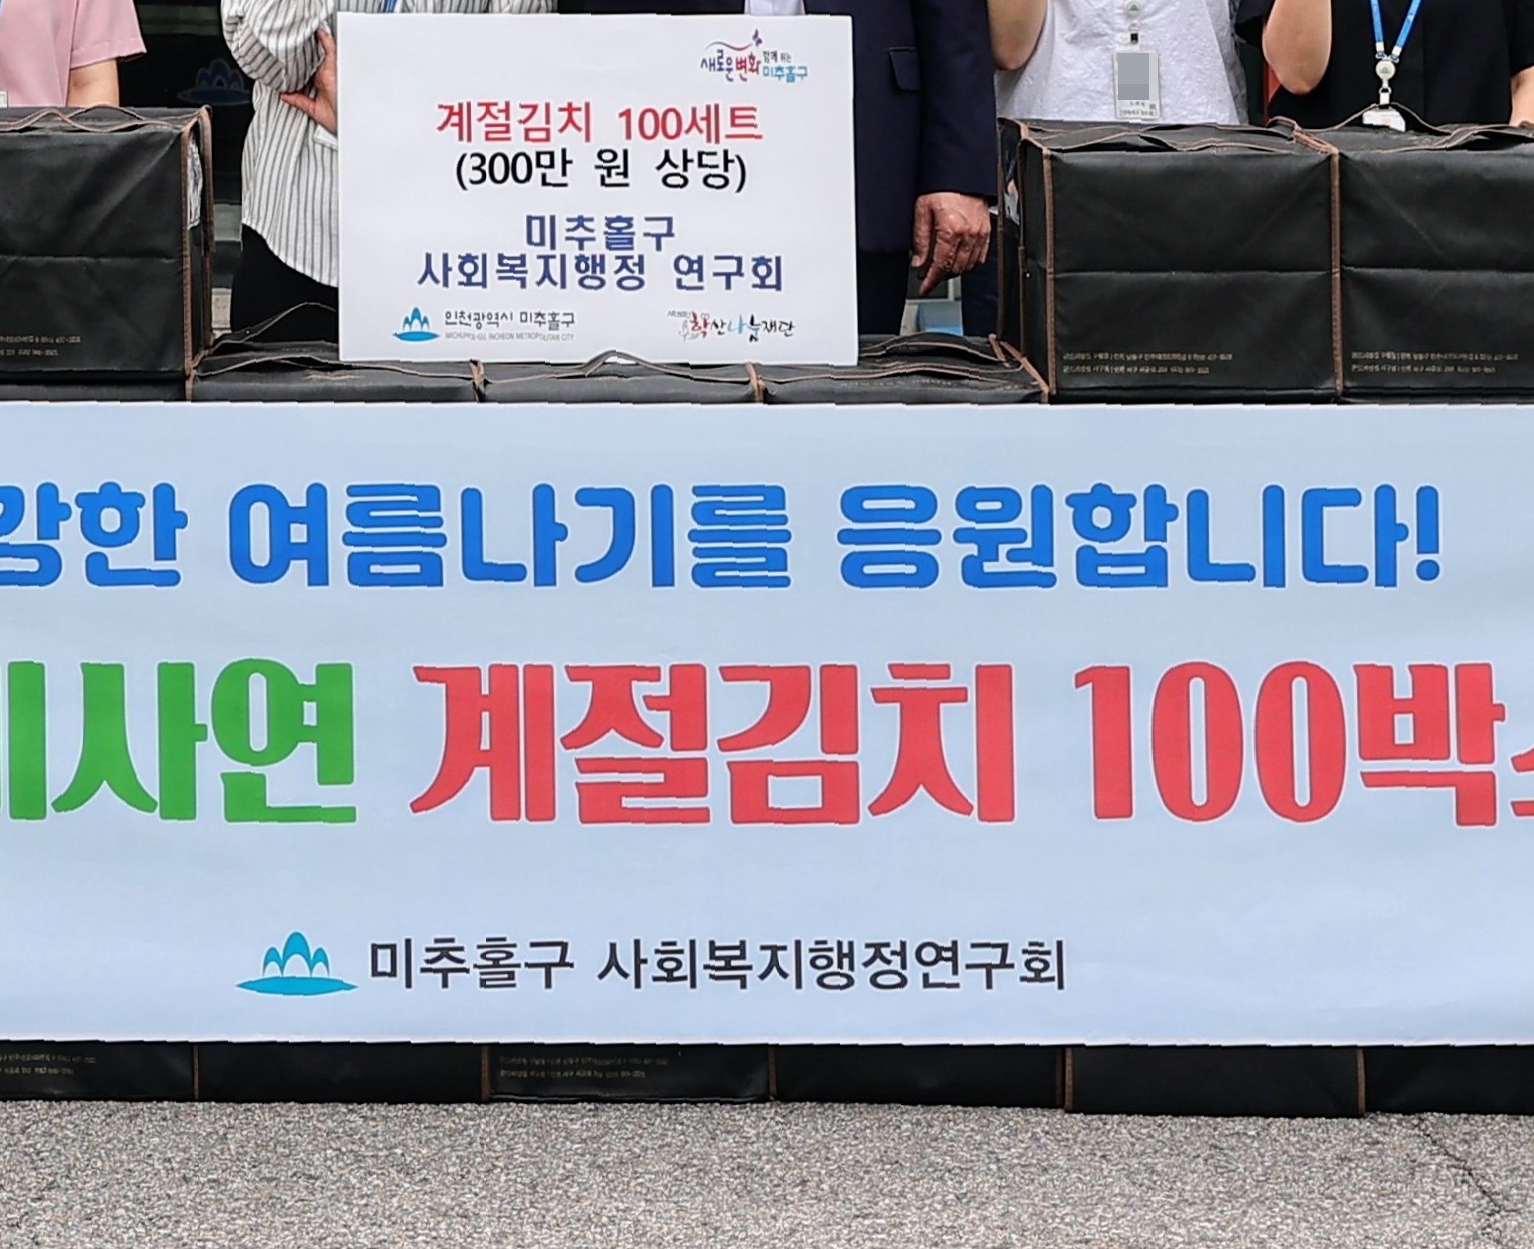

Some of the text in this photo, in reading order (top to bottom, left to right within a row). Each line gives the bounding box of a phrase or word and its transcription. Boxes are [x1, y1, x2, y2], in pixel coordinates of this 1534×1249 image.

[701, 49, 761, 82] 새로운 변화
[763, 66, 808, 83] 미추홀구
[436, 102, 762, 144] 계절김치 100세트
[455, 148, 747, 192] (300만 원 상당)
[526, 214, 676, 251] 미추홀구
[417, 252, 783, 292] 사회복지행정 연구회
[445, 310, 575, 331] 인천광역시 미추홀구
[228, 482, 793, 589] 여름나기를
[836, 482, 1441, 589] 응원합니다!
[410, 662, 1015, 825] 계절김치
[370, 936, 1065, 991] 미추홀구 사회복지행정연구회
